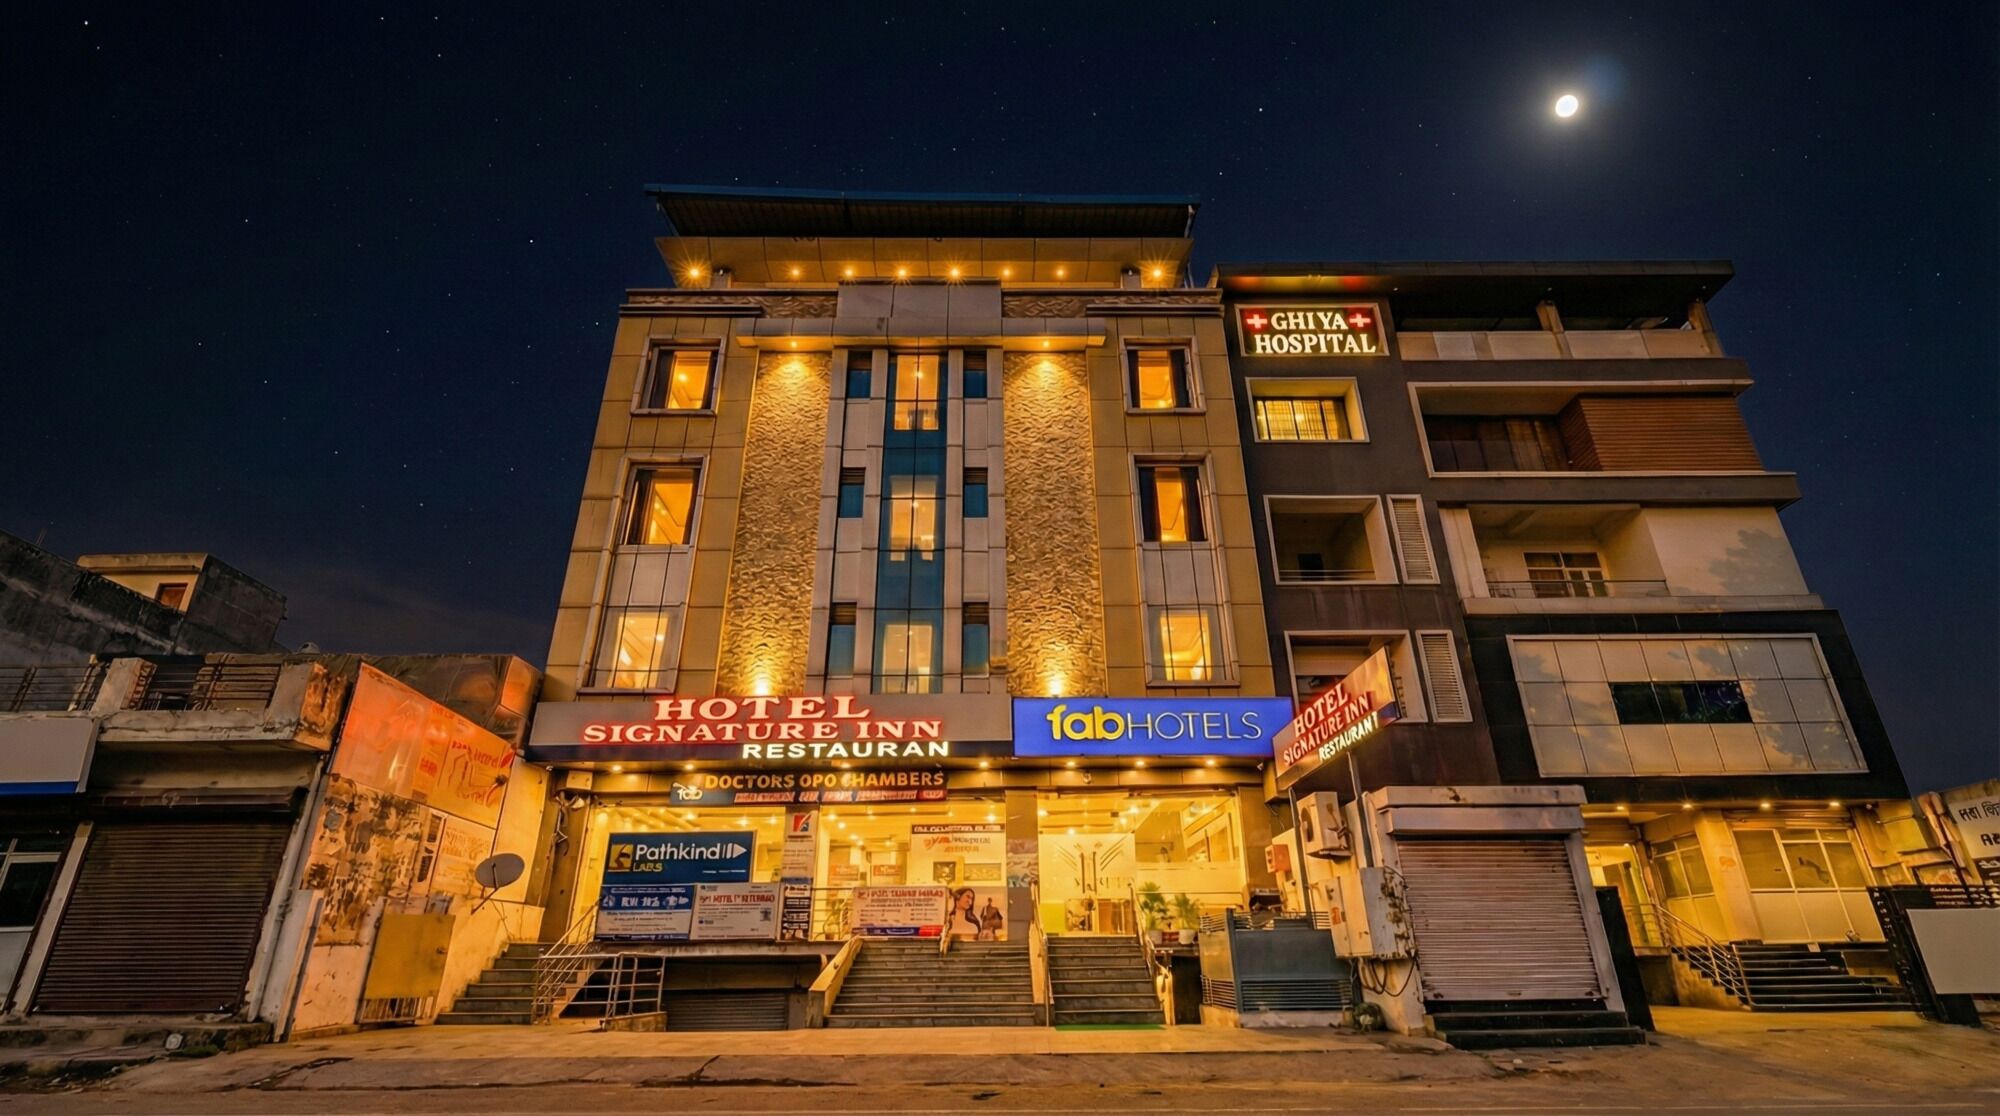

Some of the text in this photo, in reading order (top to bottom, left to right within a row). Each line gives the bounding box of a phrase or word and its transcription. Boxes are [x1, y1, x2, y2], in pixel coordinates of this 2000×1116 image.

[1254, 333, 1376, 353] HOSPITAL
[655, 696, 869, 721] HOTEL
[1293, 683, 1348, 737] HOTEL
[583, 721, 943, 743] SIGNATURE INN
[1046, 704, 1262, 740] fabHOTELS
[1283, 692, 1370, 766] SIGNATURE INN
[1319, 711, 1378, 761] RESTAURANT
[742, 741, 950, 759] RESTAURAN
[705, 774, 795, 790] DOCTORS
[841, 771, 944, 786] CHAMBERS
[635, 843, 720, 860] Pathkind
[633, 863, 662, 872] LABS
